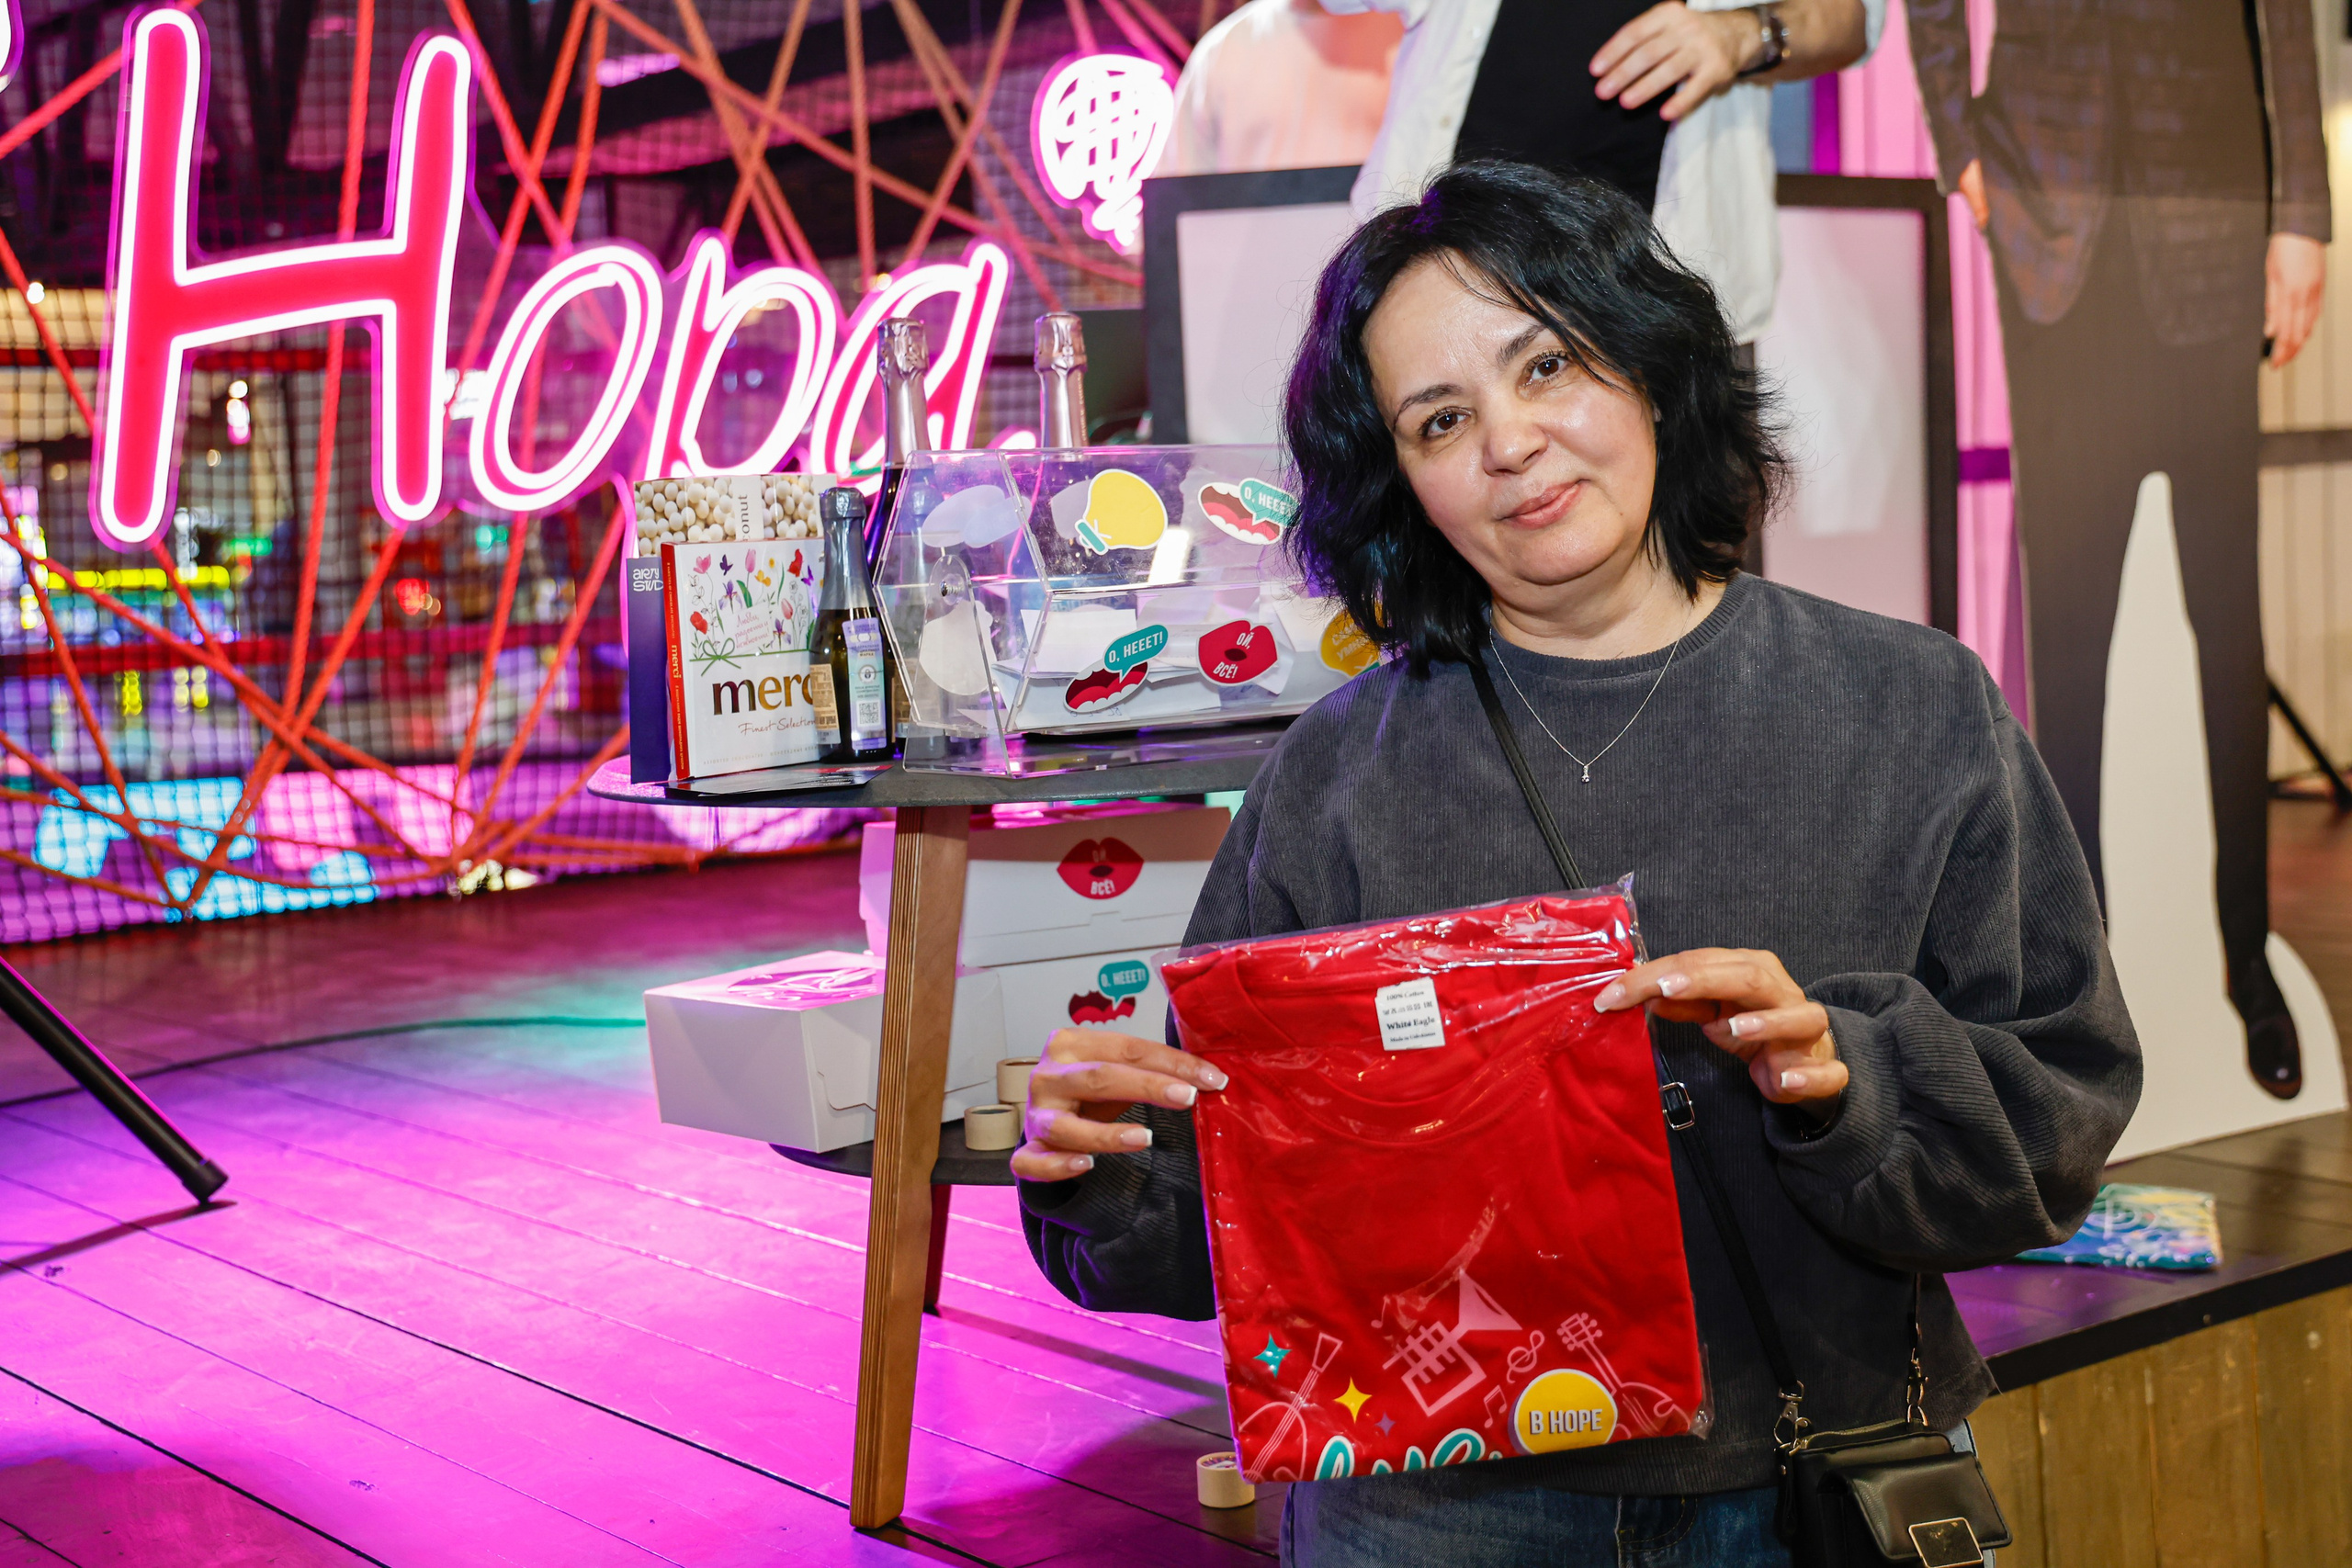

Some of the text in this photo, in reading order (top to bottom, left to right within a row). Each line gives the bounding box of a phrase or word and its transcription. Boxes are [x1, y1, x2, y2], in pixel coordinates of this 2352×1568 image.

[1108, 631, 1163, 663] О, НЕЕЕТ!
[1236, 632, 1255, 650] ОЙ,
[672, 644, 682, 679] merci
[1213, 661, 1238, 679] ВСЁ!
[1091, 878, 1115, 896] ВСЁ!
[1113, 968, 1147, 985] НЕЕЕТ!
[1386, 1016, 1435, 1030] White Eagle
